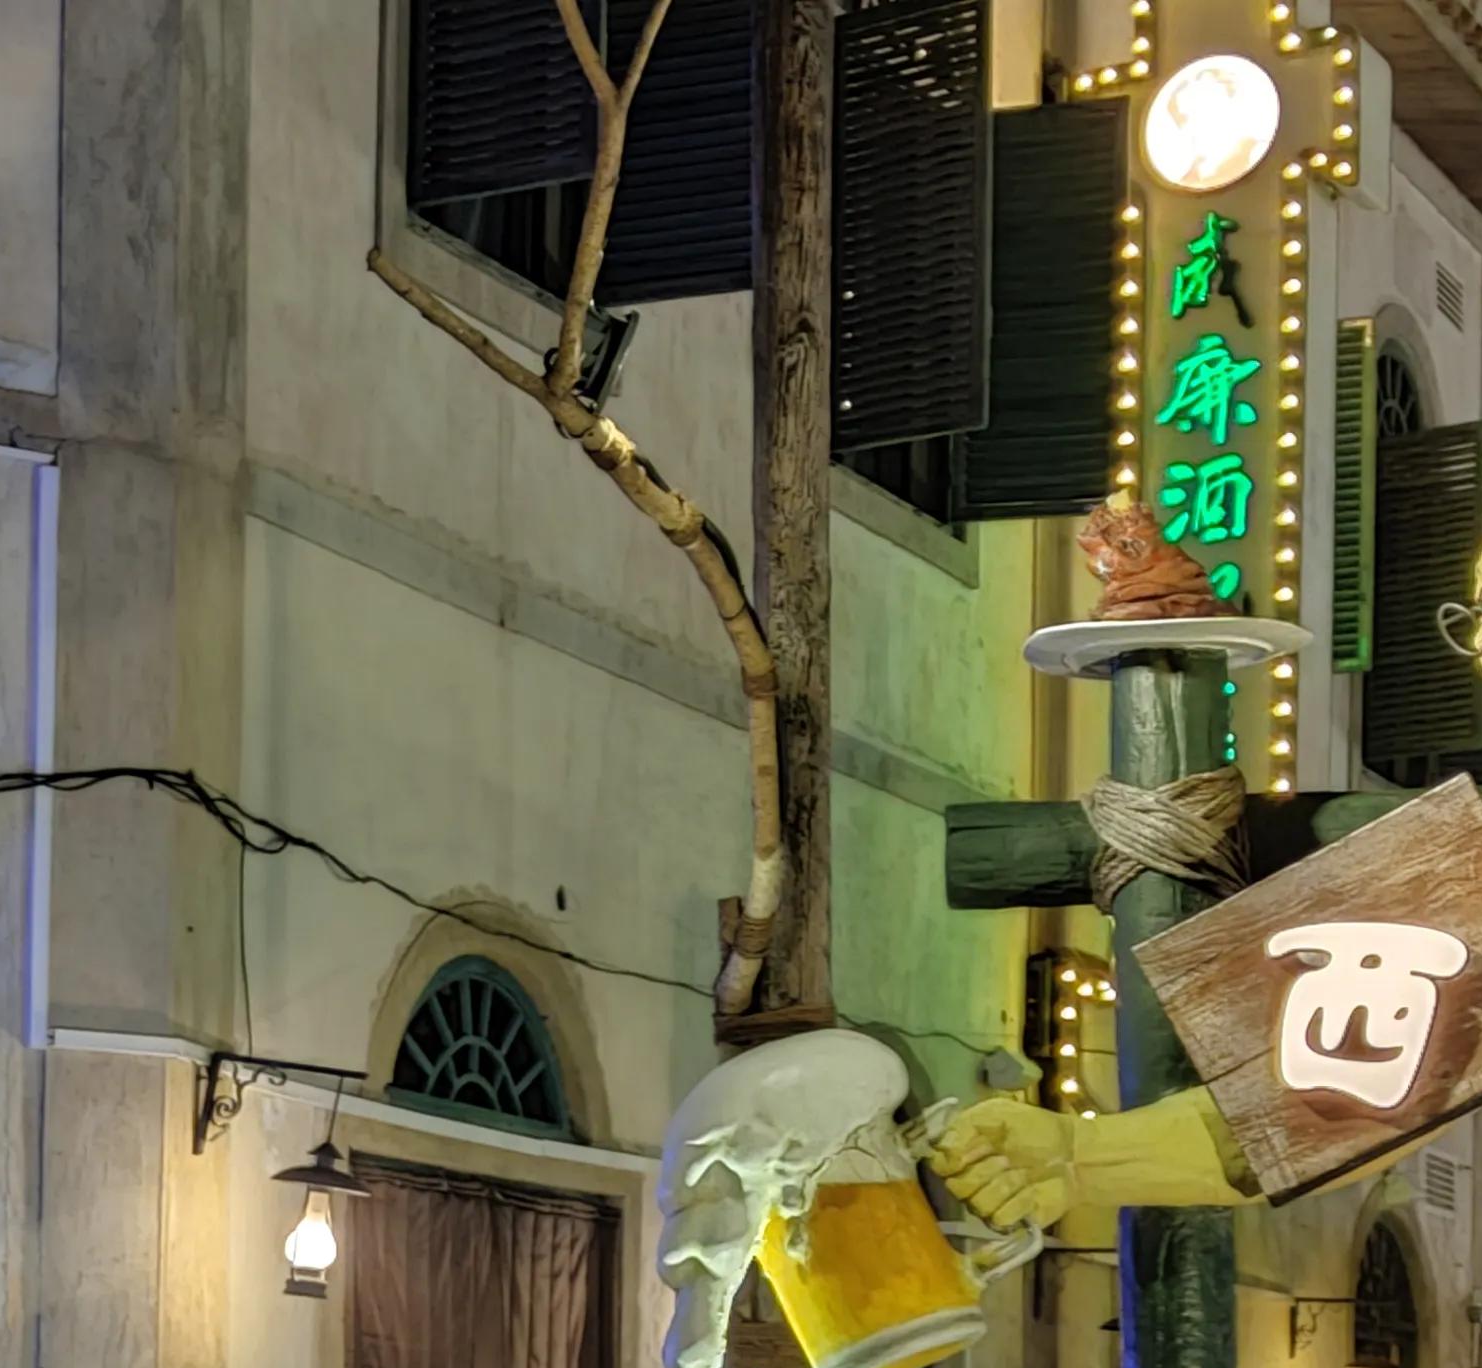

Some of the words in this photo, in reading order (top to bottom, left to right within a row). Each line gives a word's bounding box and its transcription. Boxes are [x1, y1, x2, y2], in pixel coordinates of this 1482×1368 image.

[1155, 211, 1261, 600] 威廉酒
[1266, 921, 1468, 1109] 西
